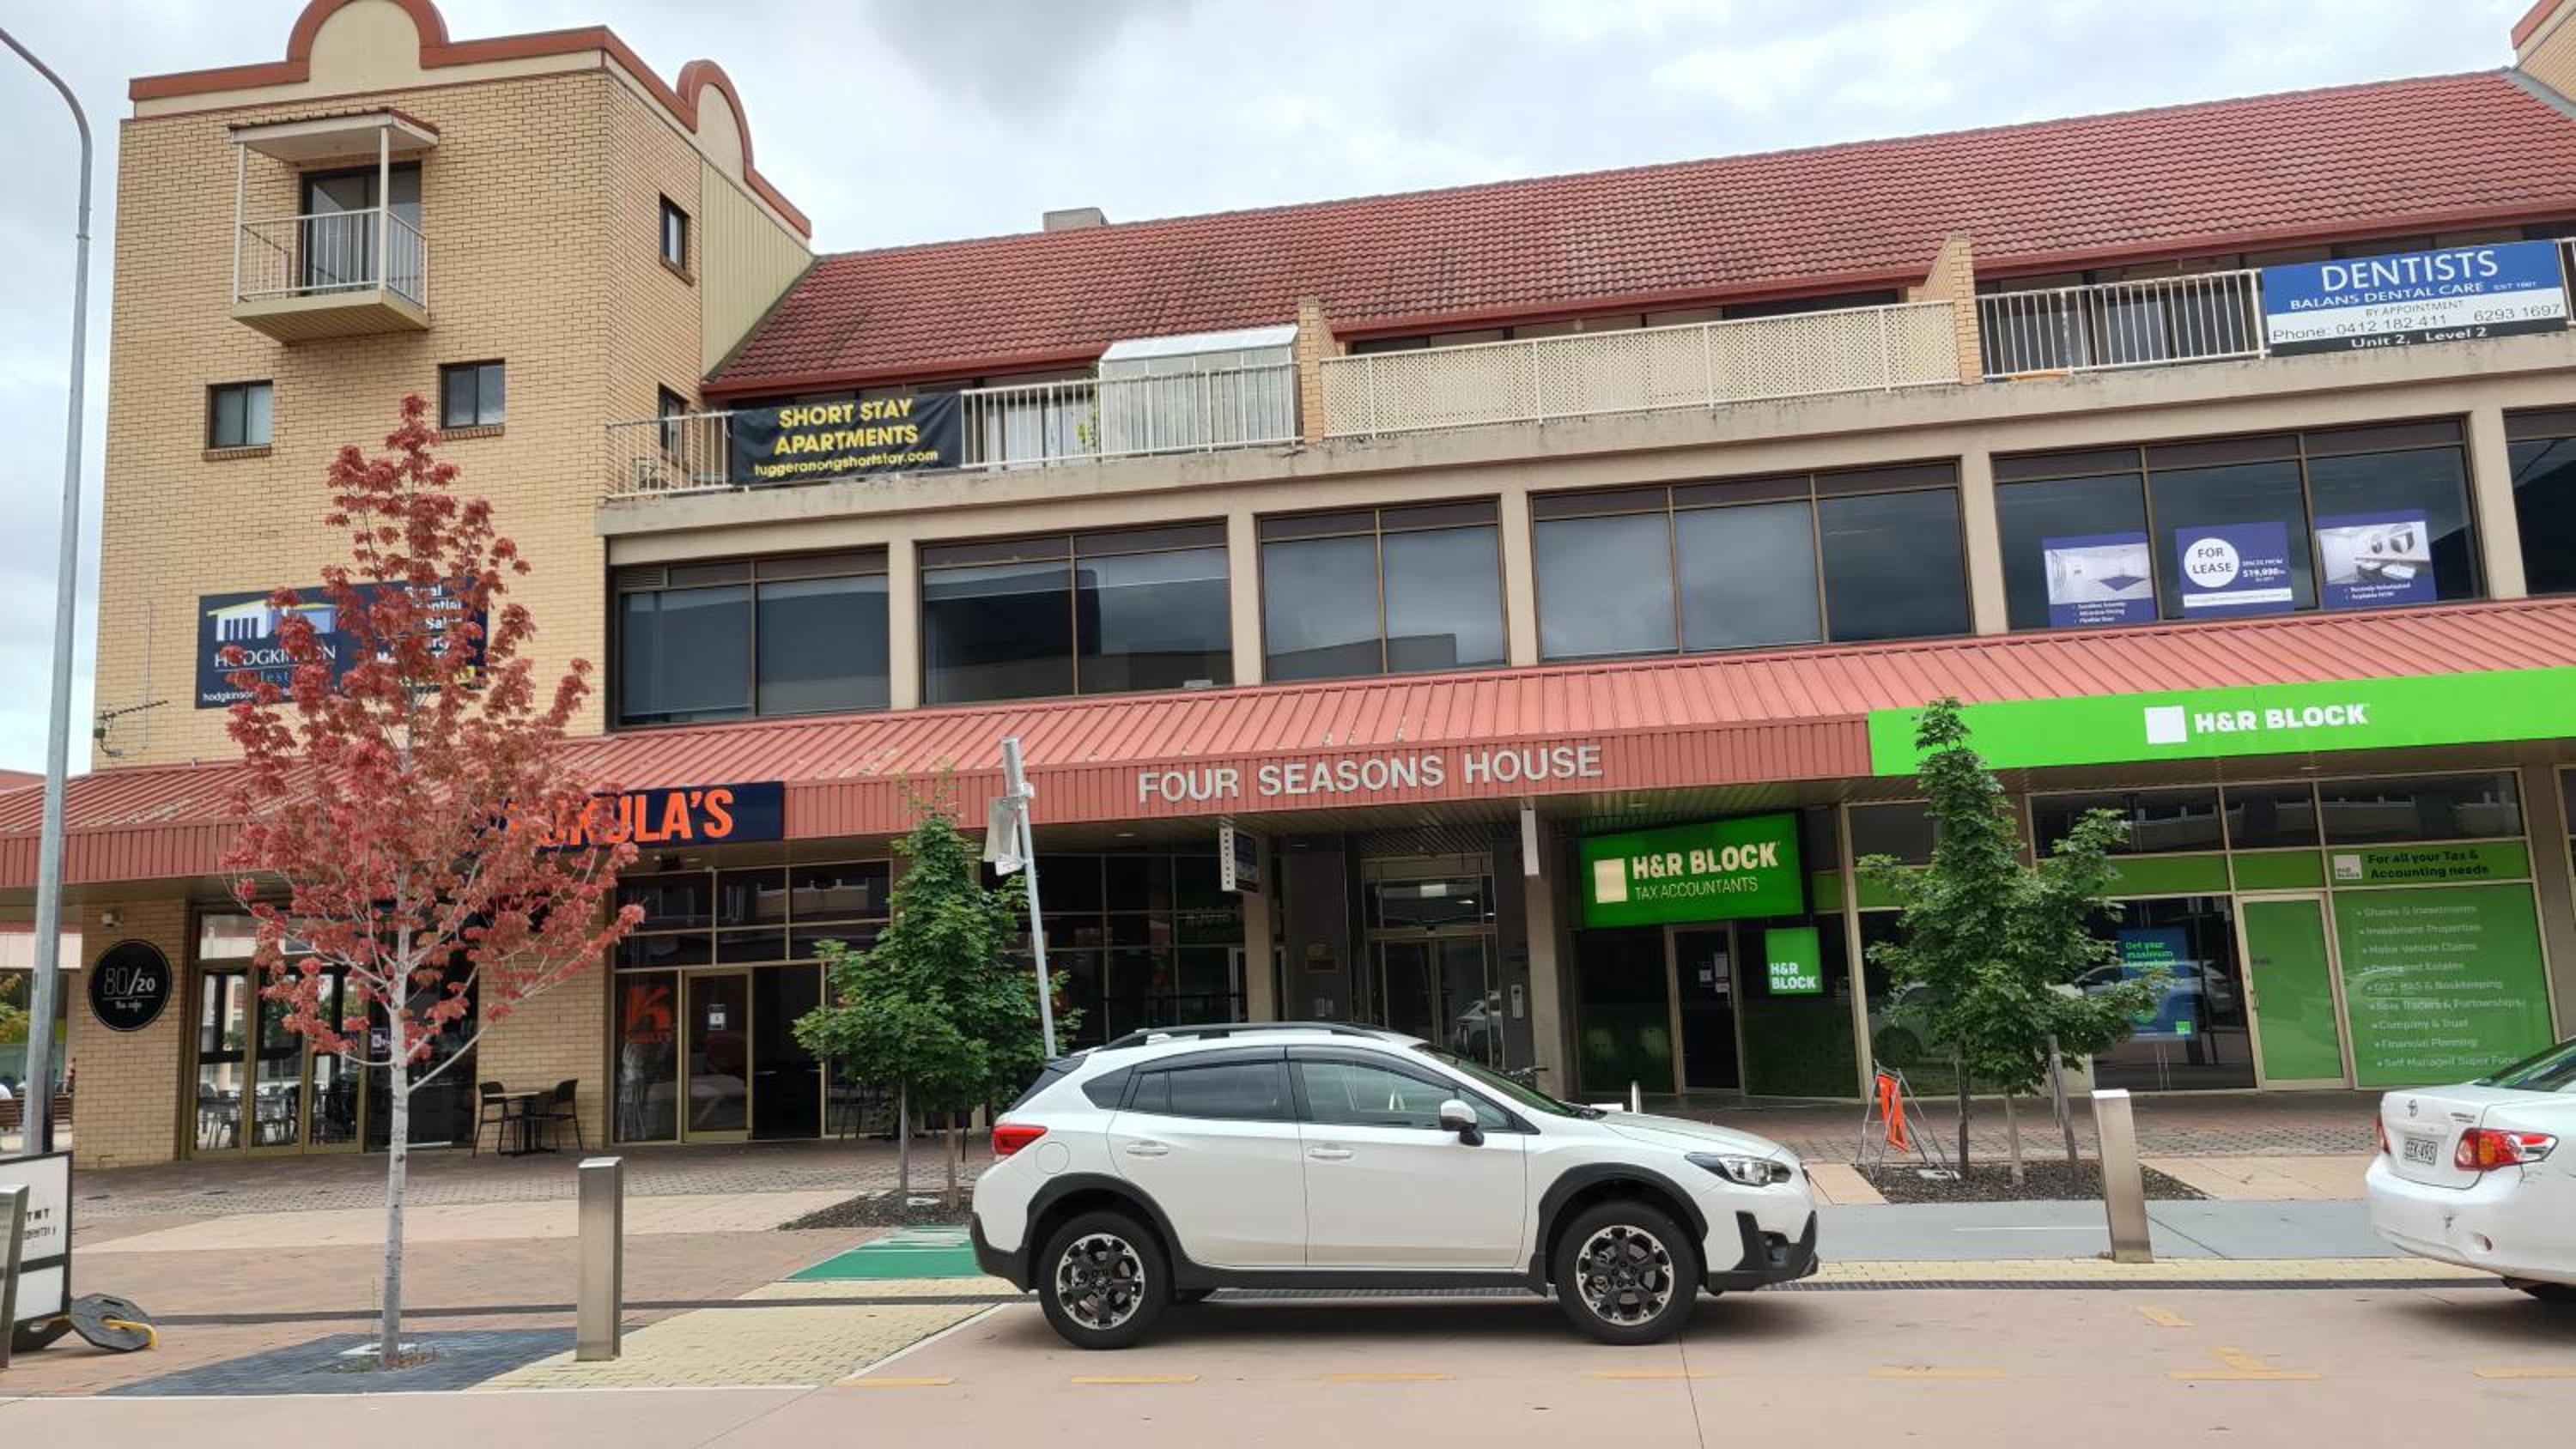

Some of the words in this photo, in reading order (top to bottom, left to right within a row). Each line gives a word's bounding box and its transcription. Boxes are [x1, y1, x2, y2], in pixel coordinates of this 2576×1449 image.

[2322, 250, 2499, 291] DENTISTS
[2290, 294, 2359, 310] BALANS
[2364, 288, 2435, 302] DENTAL
[2438, 282, 2485, 294] CARE
[2381, 300, 2464, 316] APPOINTMENT
[2273, 326, 2330, 341] Phone:
[2336, 320, 2378, 336] 0412
[2384, 317, 2413, 331] 182
[2417, 313, 2447, 328] 411
[2474, 308, 2516, 322] 6293
[2522, 303, 2561, 318] 1697
[2350, 335, 2392, 349] Unit
[2395, 333, 2411, 346] 2,
[2424, 328, 2472, 343] Level
[2476, 326, 2488, 338] 2
[779, 404, 854, 428] SHORT
[860, 397, 913, 421] STAY
[775, 424, 919, 455] APARTMENTS
[754, 449, 939, 478] tuggeranongshortstay.com
[2197, 548, 2224, 558] FOR
[2192, 562, 2233, 574] LEASE
[2194, 710, 2258, 734] H&R
[2264, 703, 2370, 730] BLOCK
[1139, 767, 1239, 803] FOUR
[1258, 754, 1444, 797] SEASONS
[1464, 744, 1603, 784] HOUSE
[1632, 852, 1684, 880] H&R
[1689, 841, 1778, 876] BLOCK
[2368, 853, 2390, 866] For
[2391, 852, 2409, 864] all
[2409, 852, 2440, 864] your
[2443, 850, 2467, 862] Tax
[2371, 865, 2446, 880] Accounting
[2447, 864, 2489, 876] needs
[1635, 885, 1658, 901] TAX
[1662, 876, 1759, 899] ACCOUNTANTS
[2412, 905, 2478, 915] Investments
[2402, 943, 2439, 953] Vehicle
[1770, 962, 1799, 976] H&R
[104, 967, 156, 996] 80/20
[1771, 976, 1817, 990] BLOCK
[2379, 1019, 2429, 1031] Company
[2442, 1018, 2469, 1028] Trust
[2381, 1039, 2430, 1048] Financial
[2431, 1037, 2478, 1048] Planning
[2384, 1058, 2404, 1067] Self
[2406, 1057, 2455, 1068] Managed
[2458, 1056, 2488, 1067] Super
